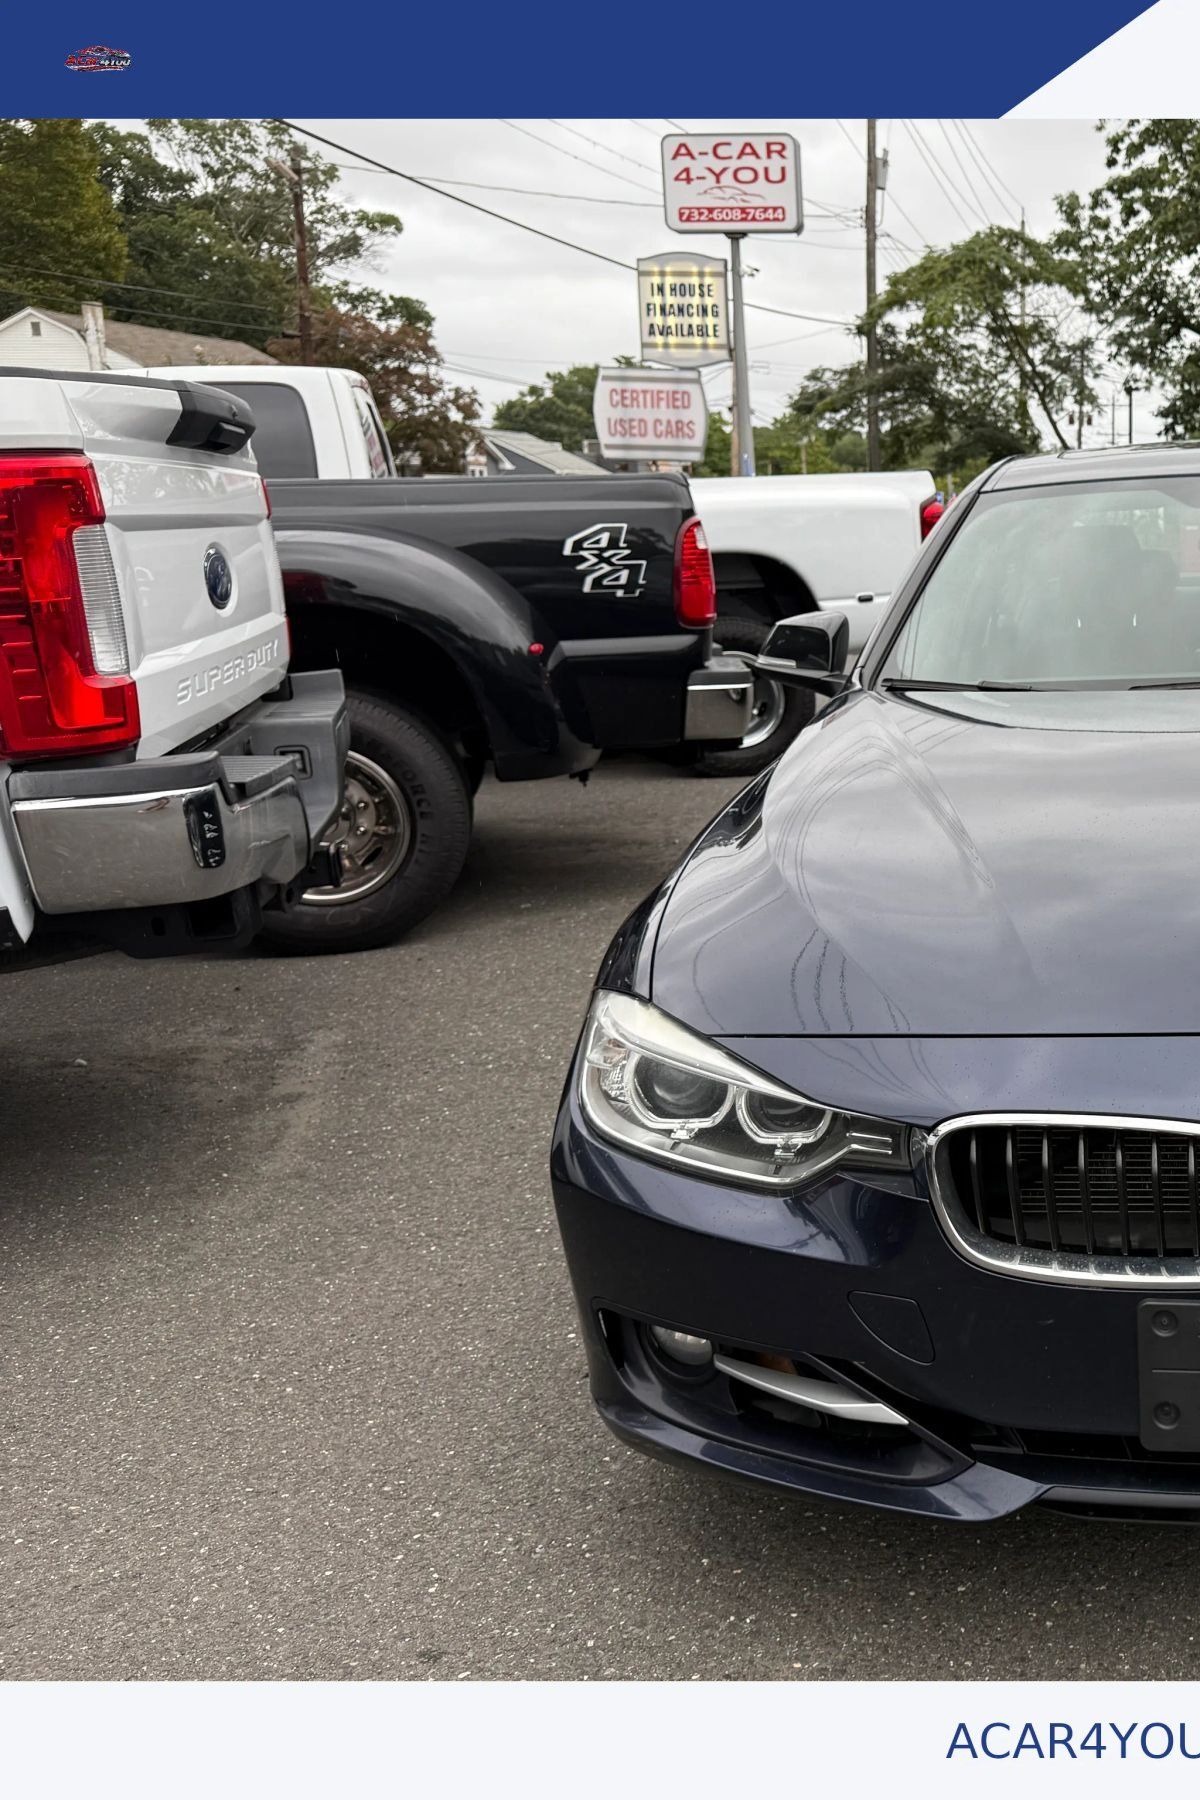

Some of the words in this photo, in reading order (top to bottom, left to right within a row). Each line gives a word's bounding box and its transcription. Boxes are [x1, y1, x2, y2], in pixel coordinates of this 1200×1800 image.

[671, 142, 788, 160] A-CAR
[673, 166, 787, 185] 4-YOU
[680, 208, 785, 221] 732-608-7644
[651, 282, 664, 297] IN
[669, 283, 713, 297] HOUSE
[646, 303, 719, 318] FINANCING
[648, 323, 719, 338] AVAILABLE
[609, 388, 692, 410] CERTIFIED
[607, 417, 648, 438] USED
[653, 418, 696, 439] CARS
[176, 656, 245, 706] SUPER
[246, 638, 279, 672] DUTY
